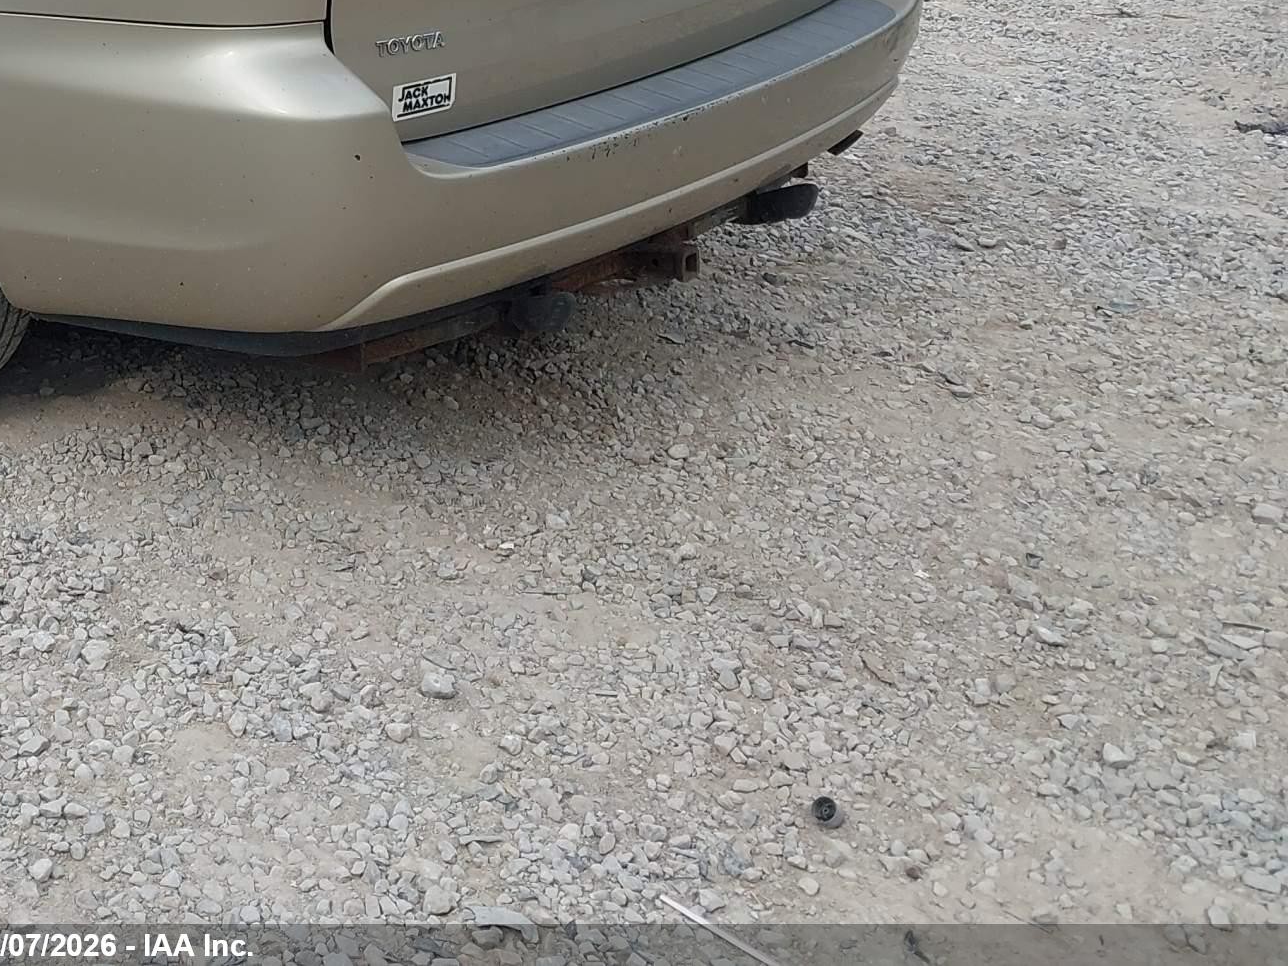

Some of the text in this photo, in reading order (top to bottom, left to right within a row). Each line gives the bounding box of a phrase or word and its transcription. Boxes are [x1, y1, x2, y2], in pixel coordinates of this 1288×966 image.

[375, 31, 446, 58] TOYOTA
[398, 85, 429, 102] JACK
[402, 93, 451, 113] MAXTON
